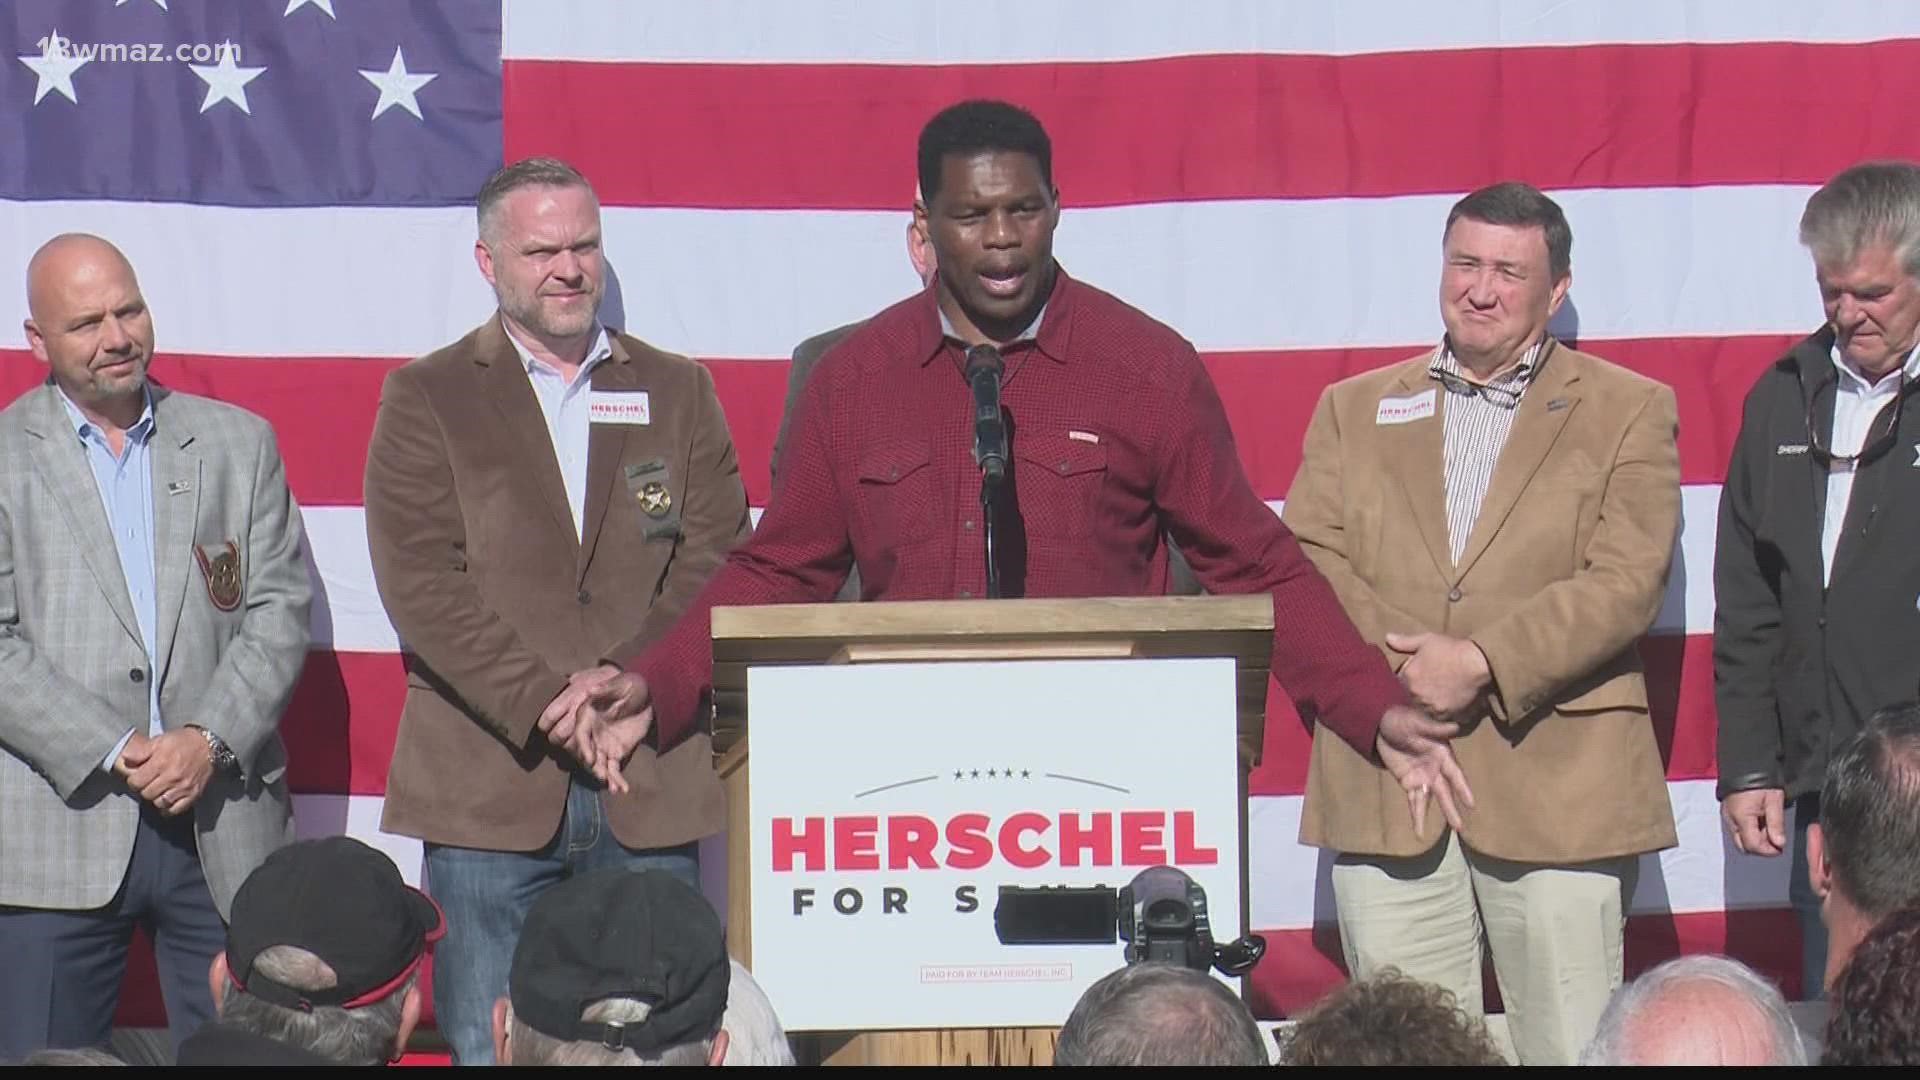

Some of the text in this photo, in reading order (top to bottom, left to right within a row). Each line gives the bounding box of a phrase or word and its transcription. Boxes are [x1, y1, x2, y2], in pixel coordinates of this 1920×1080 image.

[771, 811, 1218, 872] HERSCHEL
[793, 886, 908, 916] FOR
[926, 969, 945, 979] PAID
[947, 969, 965, 979] FOR
[967, 969, 977, 979] BY
[980, 968, 1002, 978] TEAM
